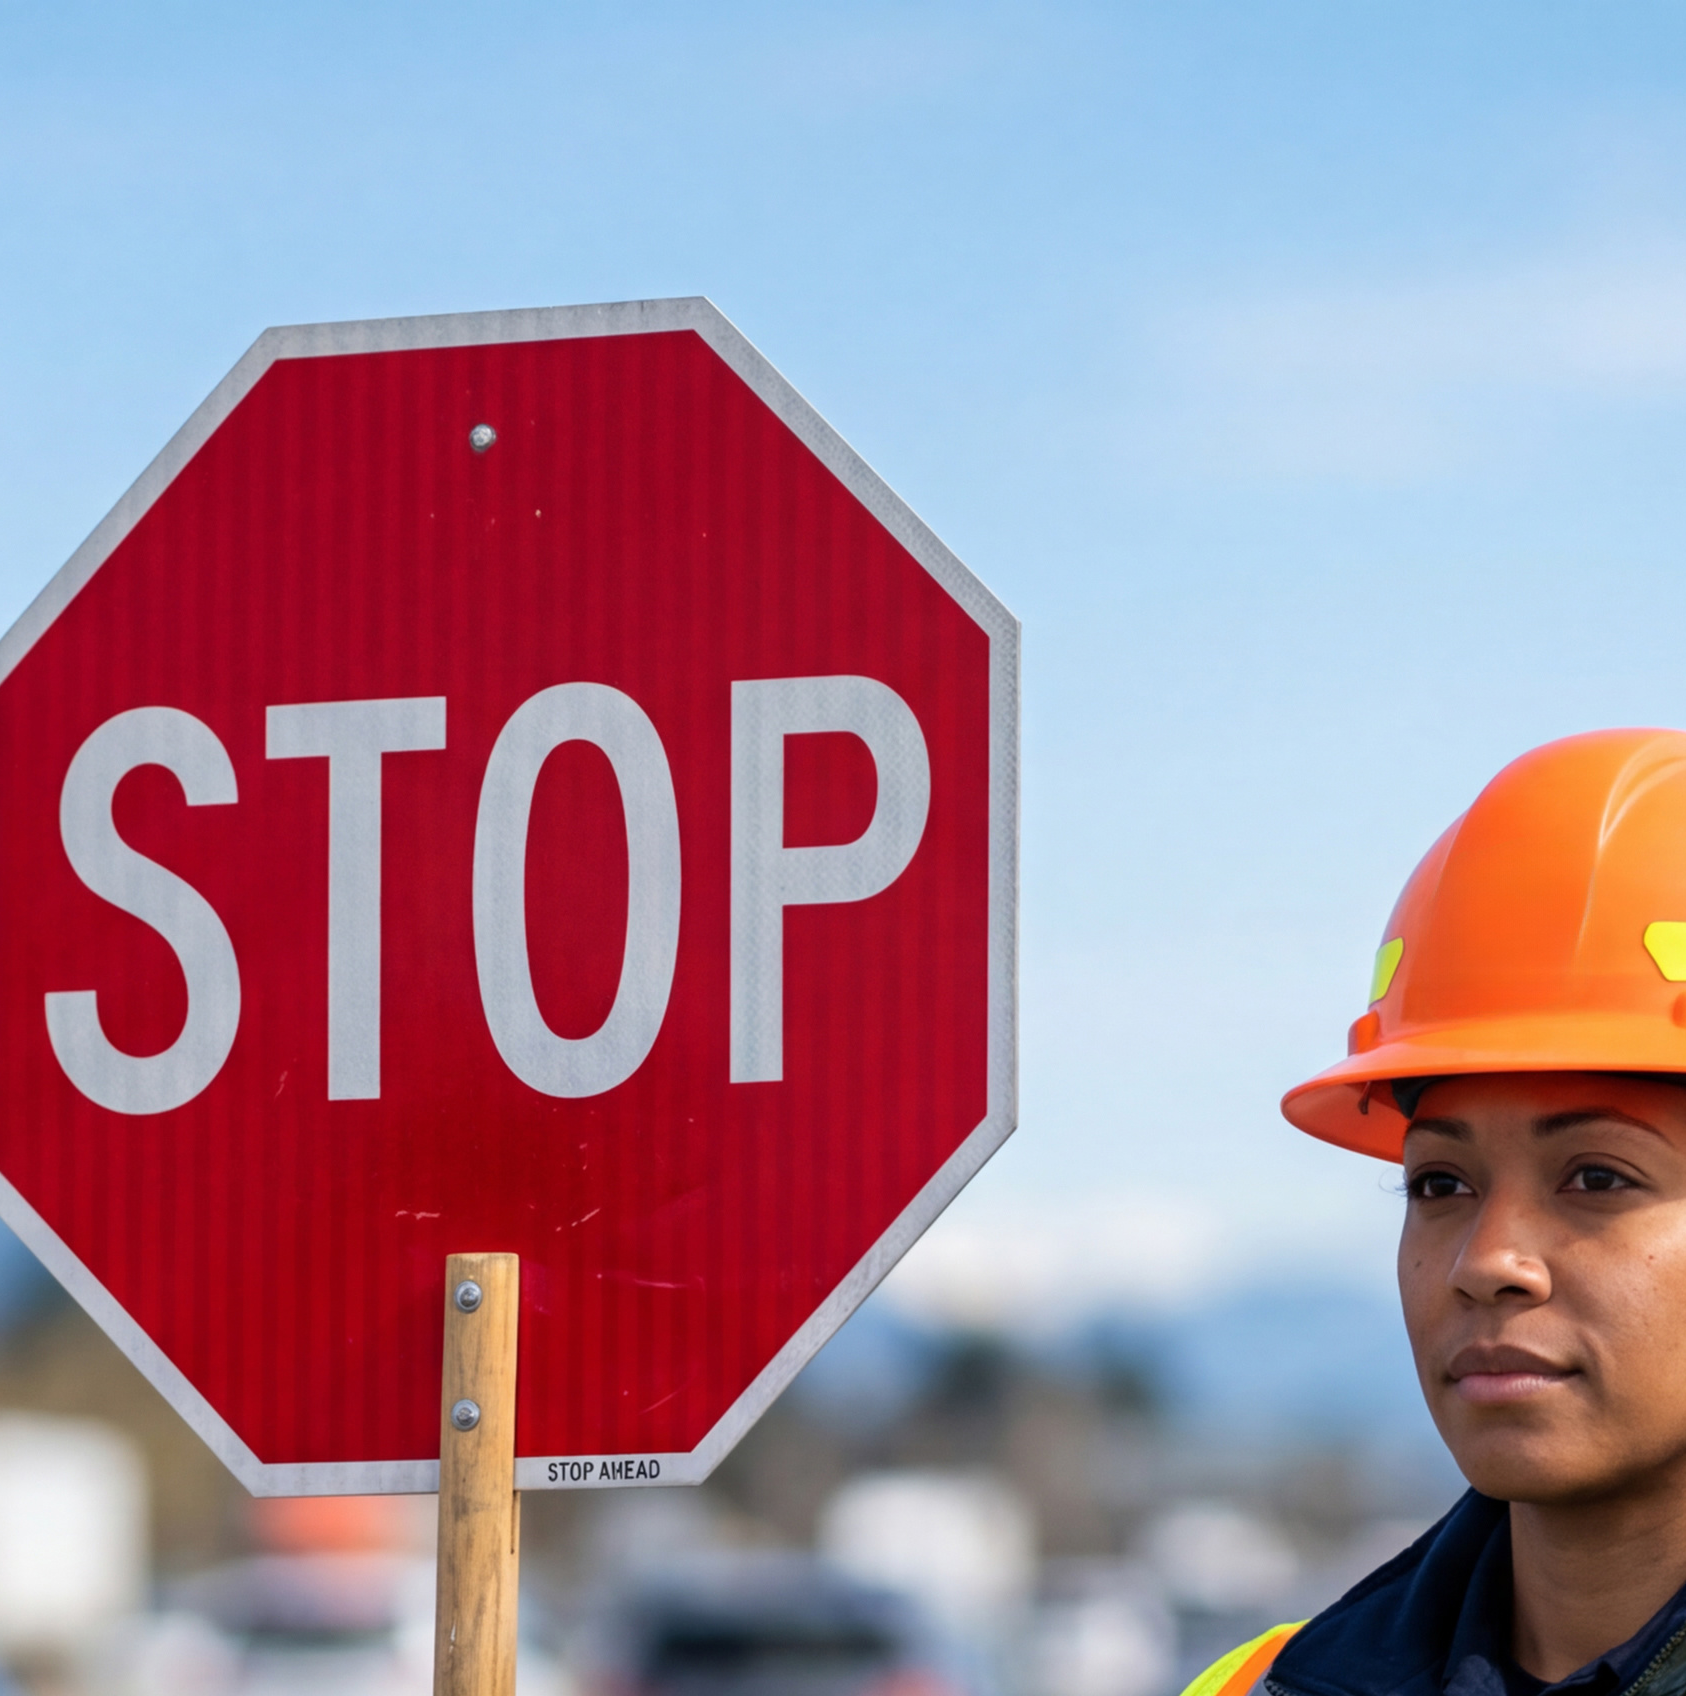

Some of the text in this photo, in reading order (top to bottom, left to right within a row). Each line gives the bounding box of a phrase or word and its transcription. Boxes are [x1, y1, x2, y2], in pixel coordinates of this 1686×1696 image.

[44, 674, 932, 1116] STOP
[548, 1459, 661, 1482] STOP AHEAD
